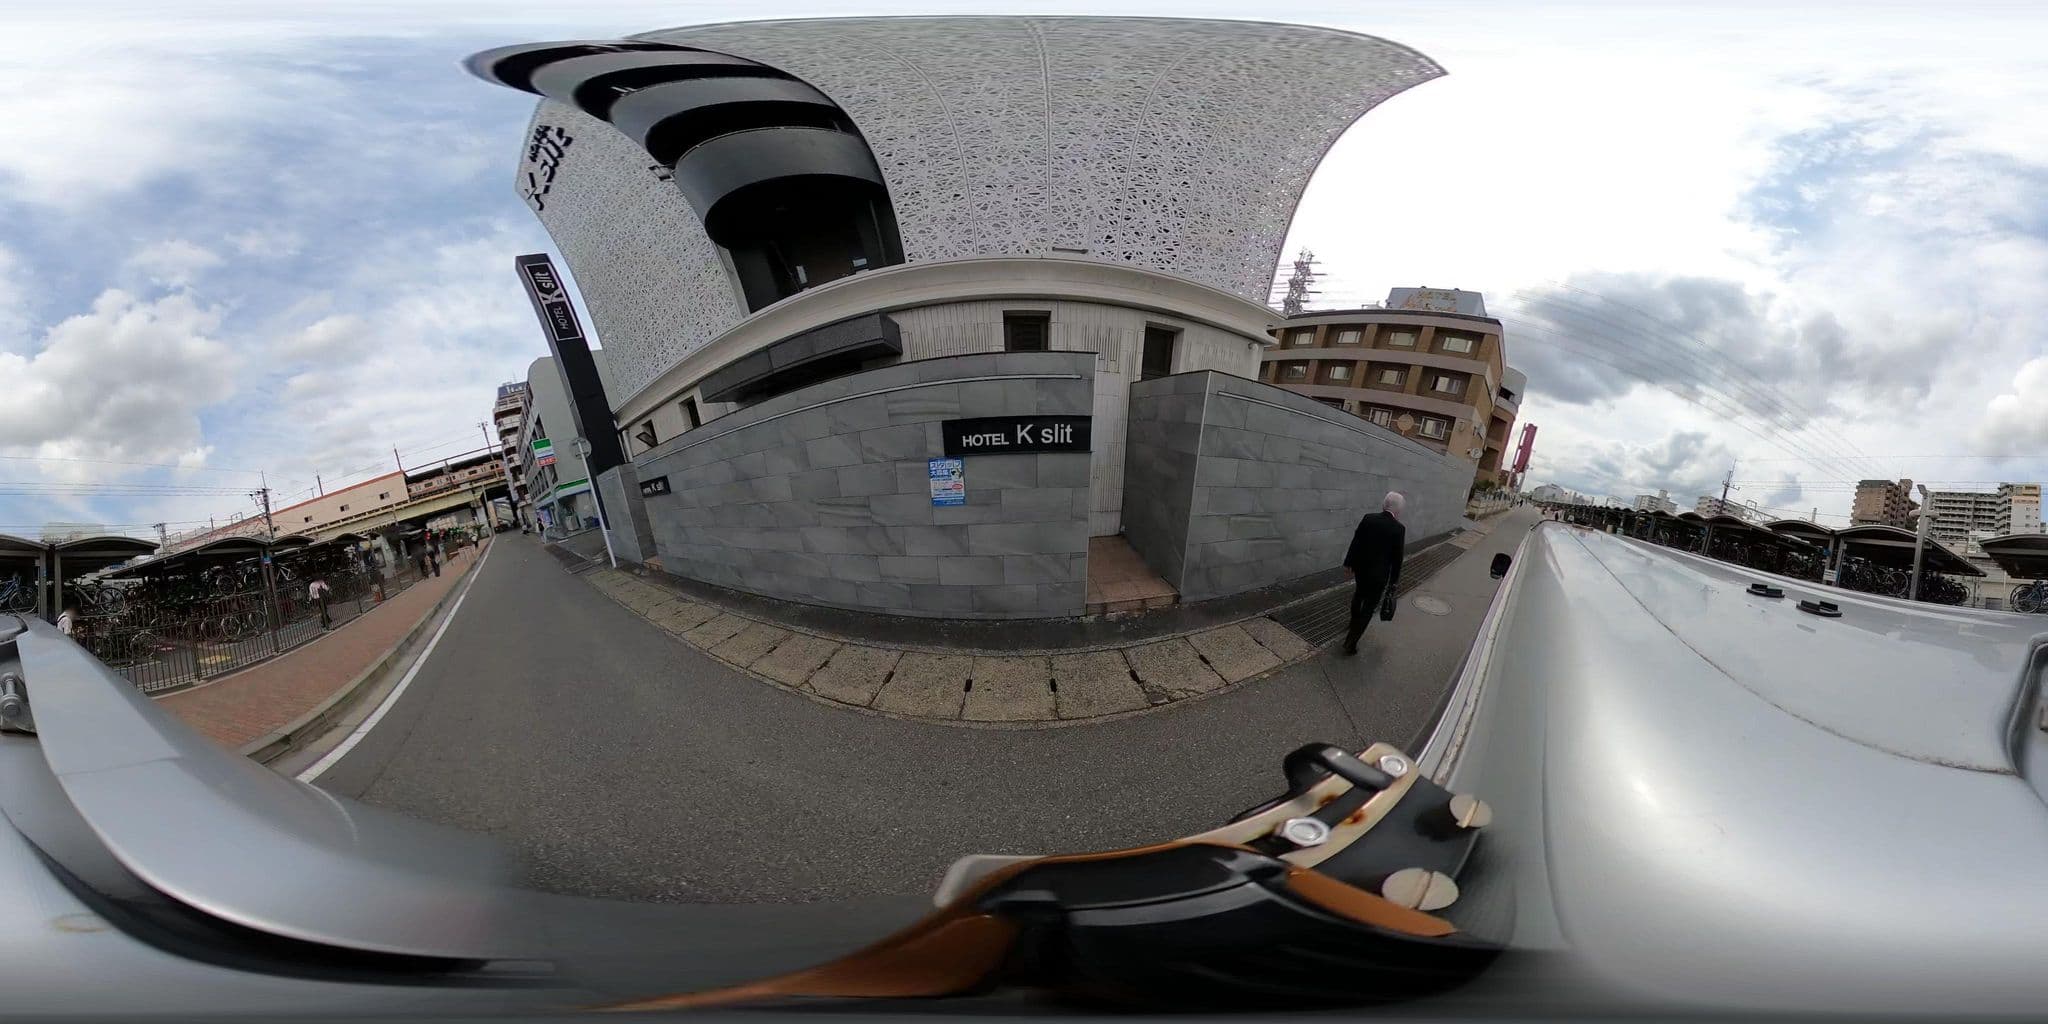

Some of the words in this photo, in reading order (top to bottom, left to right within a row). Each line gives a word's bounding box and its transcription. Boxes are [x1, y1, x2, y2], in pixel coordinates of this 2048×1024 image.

[534, 271, 555, 288] slit
[540, 288, 566, 304] K
[554, 306, 568, 329] HOTEL
[962, 433, 1009, 447] HOTEL
[1016, 424, 1033, 444] K
[1041, 423, 1073, 443] slit
